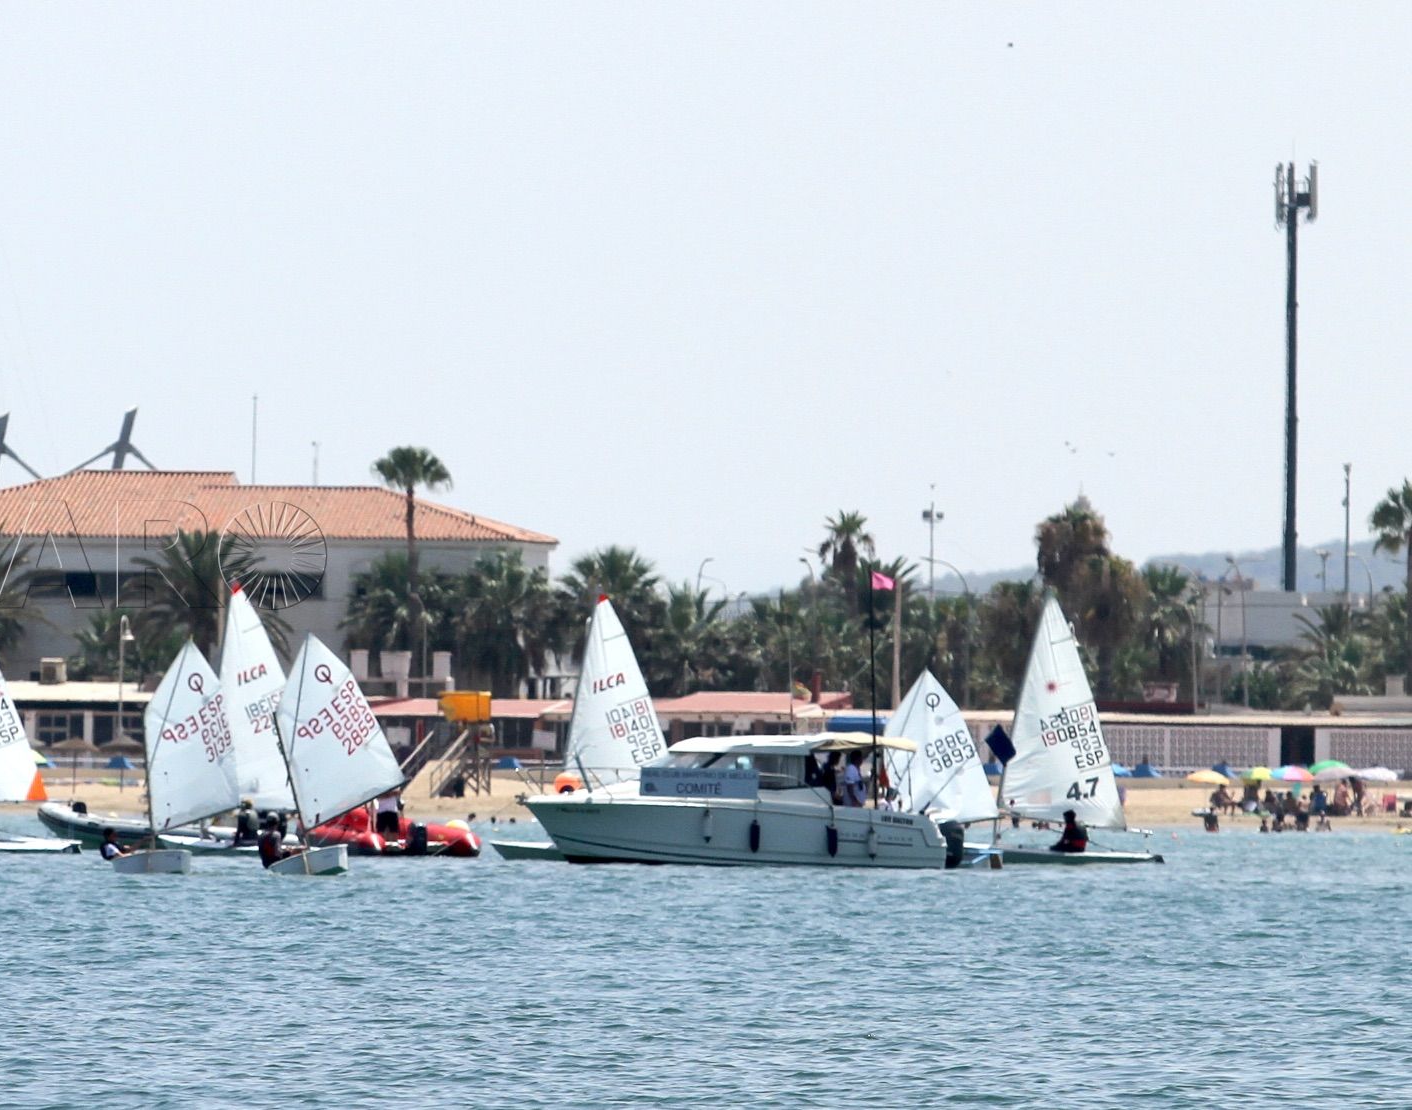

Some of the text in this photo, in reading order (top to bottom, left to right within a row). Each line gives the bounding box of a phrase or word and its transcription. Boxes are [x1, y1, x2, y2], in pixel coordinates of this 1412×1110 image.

[237, 664, 268, 686] ILCA
[593, 672, 626, 694] ILCA
[199, 694, 223, 726] ESP
[331, 680, 355, 714] ESP
[342, 716, 375, 755] 2859
[609, 714, 654, 740] 181401
[1041, 720, 1098, 748] 190854
[206, 731, 231, 763] 3139
[632, 743, 662, 764] ESP
[930, 745, 975, 773] 3893
[1074, 750, 1104, 769] ESP
[676, 782, 722, 795] COMITÉ
[1066, 777, 1100, 801] 4.7
